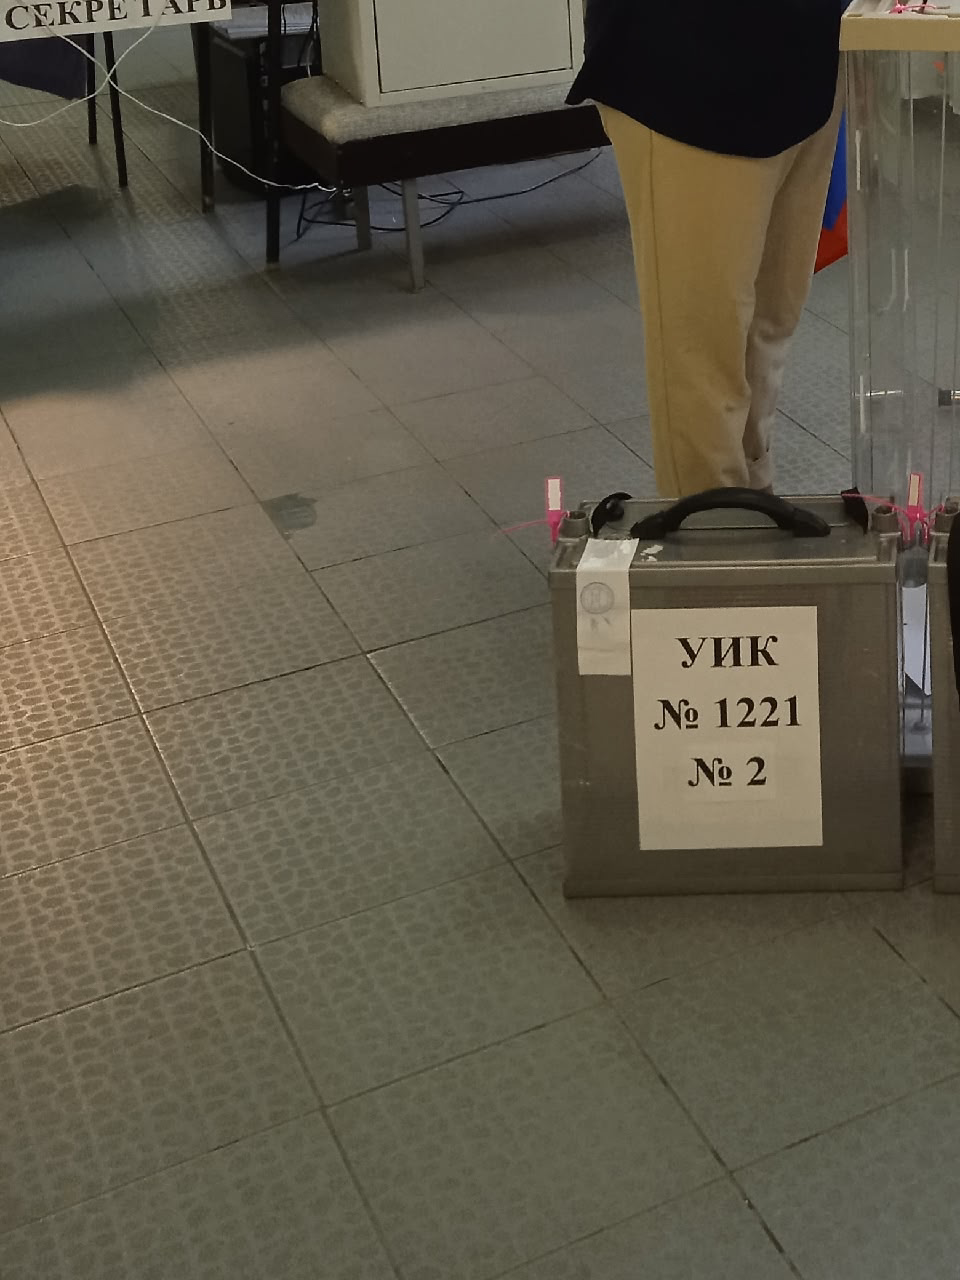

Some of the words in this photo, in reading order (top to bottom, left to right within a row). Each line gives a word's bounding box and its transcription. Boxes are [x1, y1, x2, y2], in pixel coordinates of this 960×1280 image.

[675, 635, 779, 669] УИК
[654, 699, 699, 730] №
[714, 695, 802, 728] 1221
[688, 757, 732, 787] №
[746, 756, 767, 786] 2
